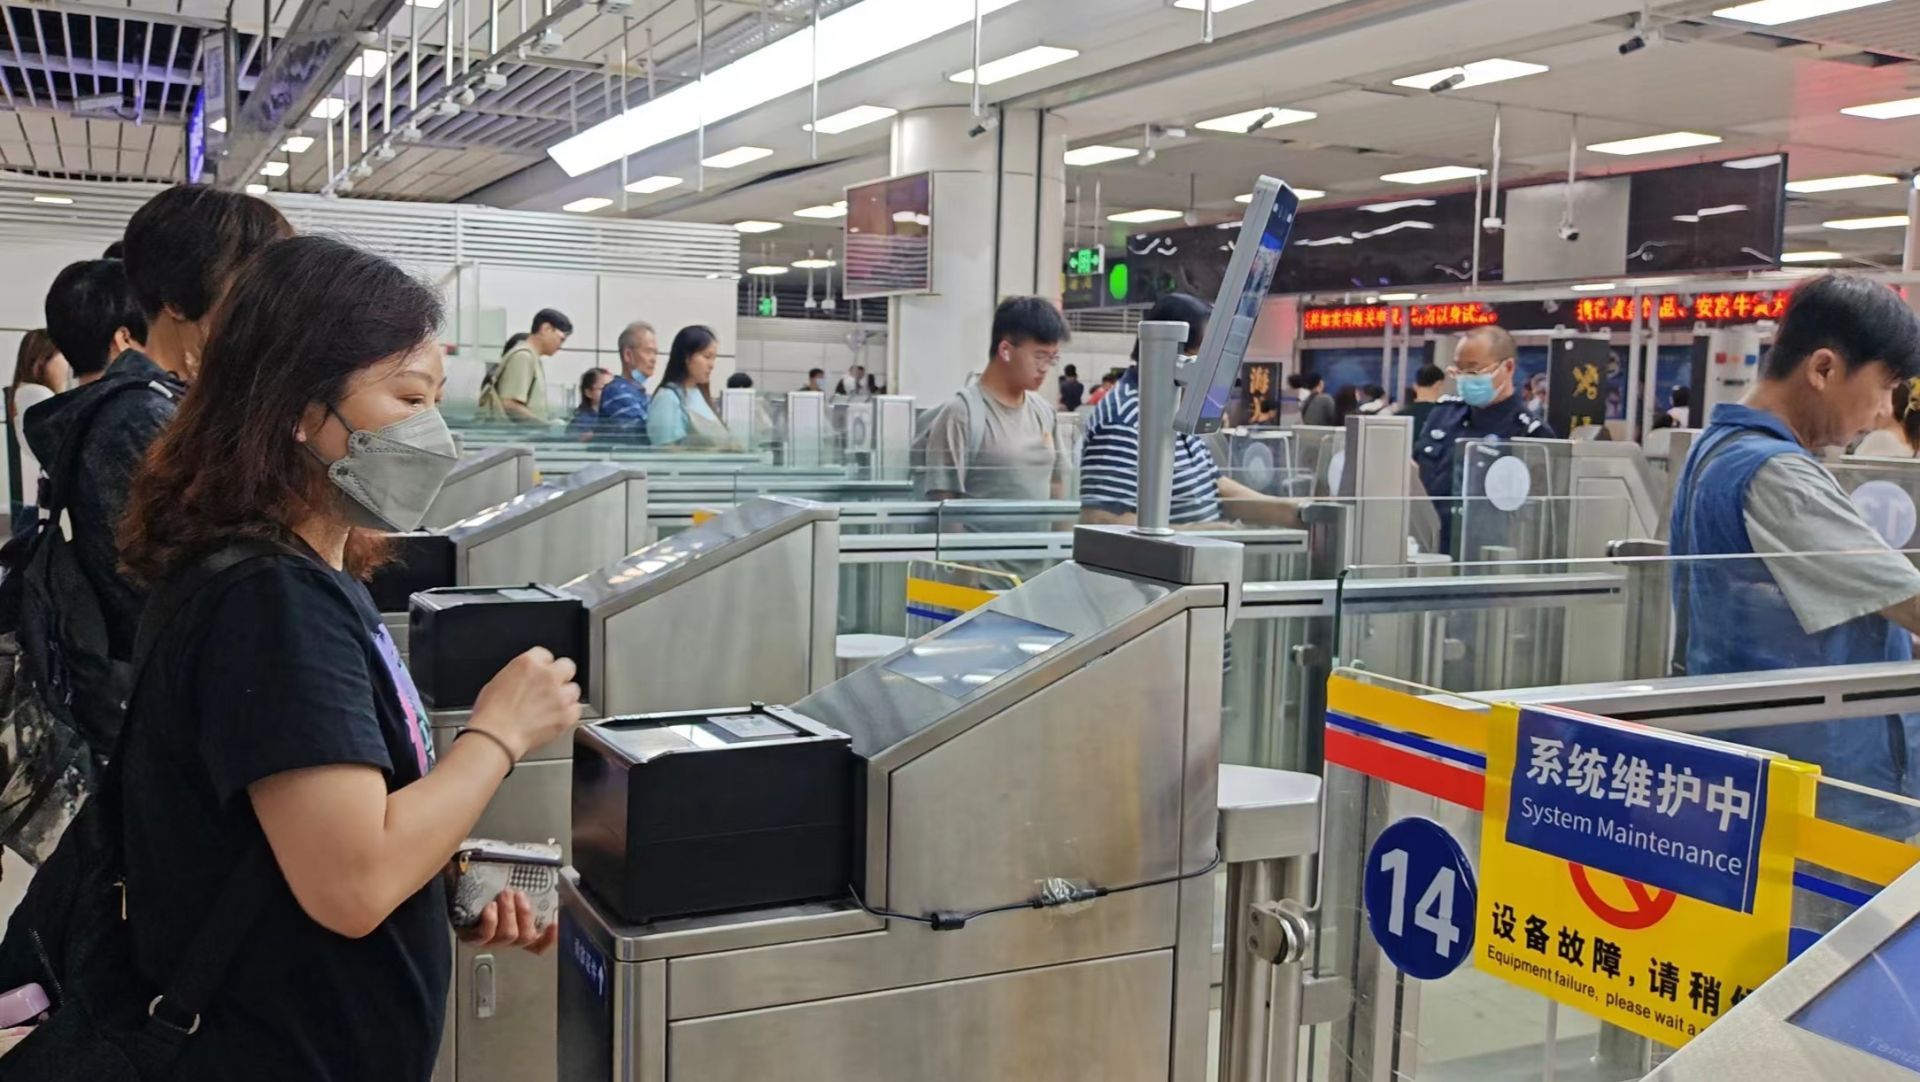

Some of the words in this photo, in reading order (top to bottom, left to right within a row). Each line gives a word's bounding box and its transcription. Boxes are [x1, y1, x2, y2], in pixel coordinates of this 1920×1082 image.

[1526, 736, 1751, 832] 系统维护中
[1521, 797, 1591, 834] System
[1597, 817, 1743, 876] Maintenance
[1381, 848, 1460, 958] 14
[1487, 945, 1552, 981] Equipment
[1555, 970, 1599, 1001] failure,
[1605, 992, 1651, 1019] please
[1655, 1008, 1684, 1031] wait
[1688, 1022, 1696, 1036] a
